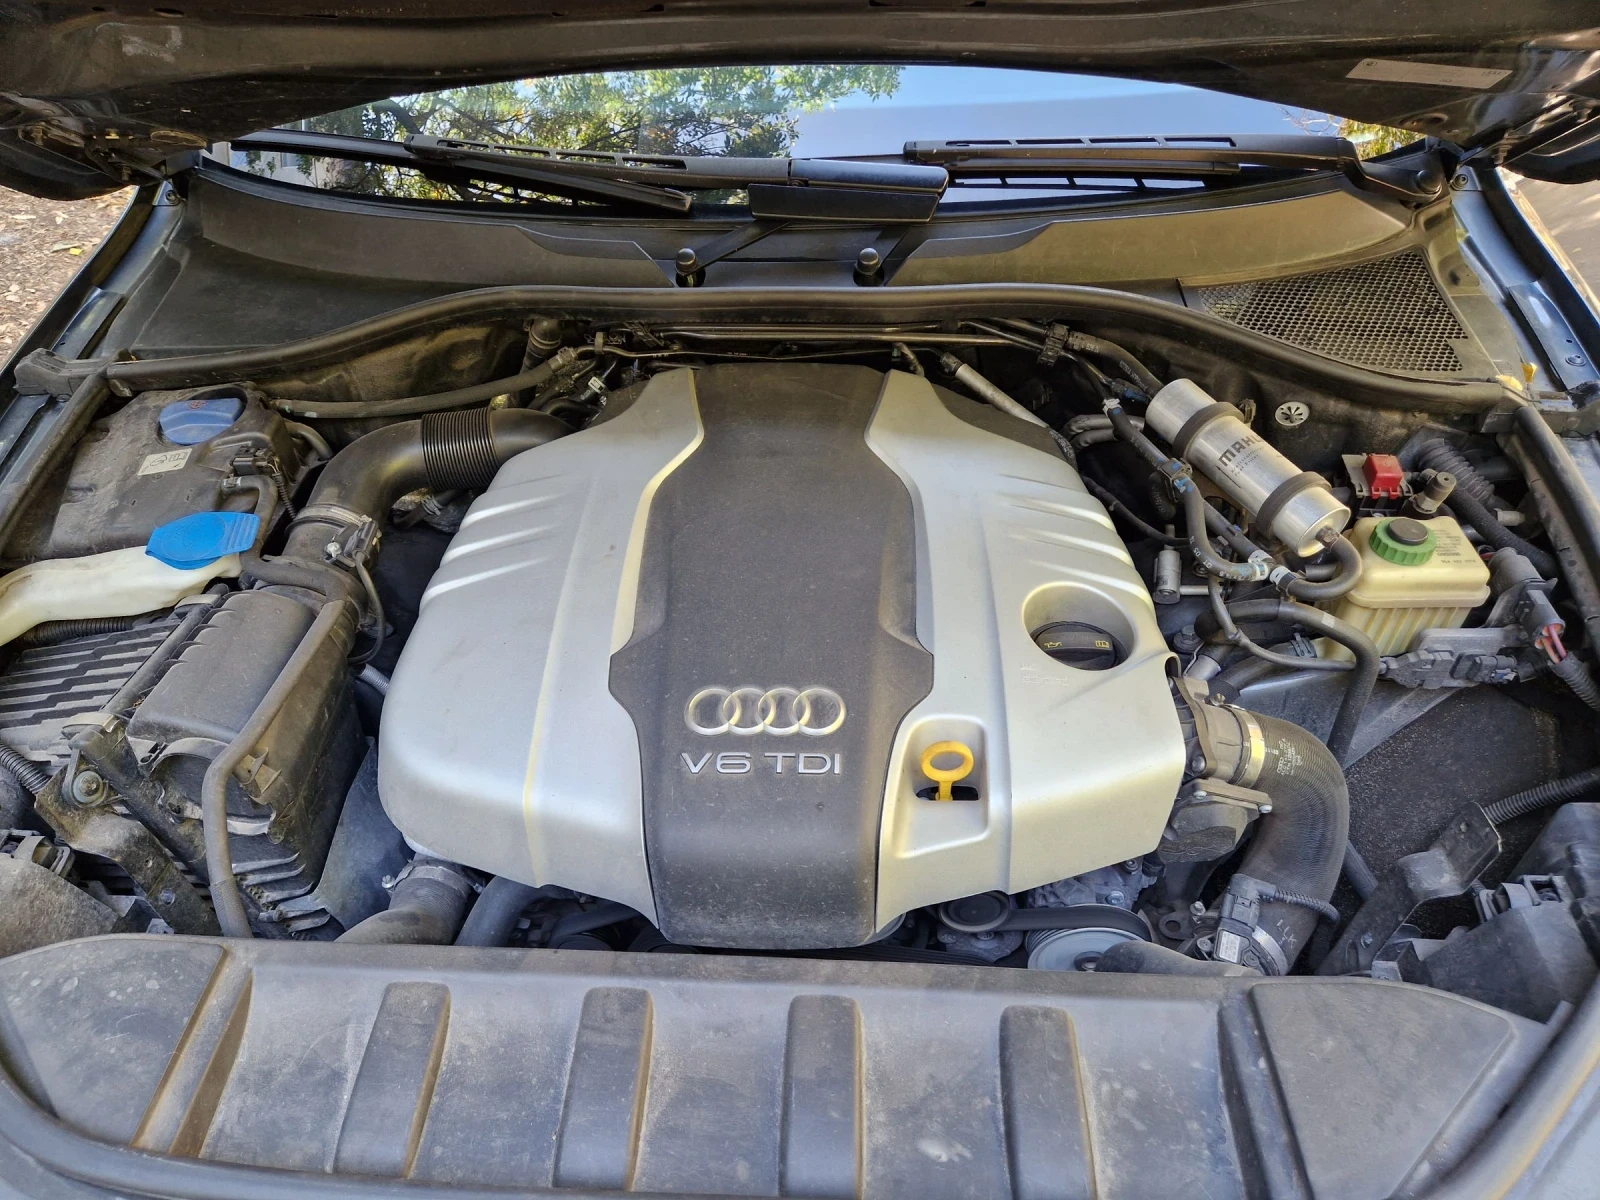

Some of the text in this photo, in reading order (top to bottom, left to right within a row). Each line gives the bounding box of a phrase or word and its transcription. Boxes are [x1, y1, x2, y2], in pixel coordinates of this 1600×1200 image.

[1218, 435, 1263, 467] MAHL
[680, 752, 841, 775] V6 TDI
